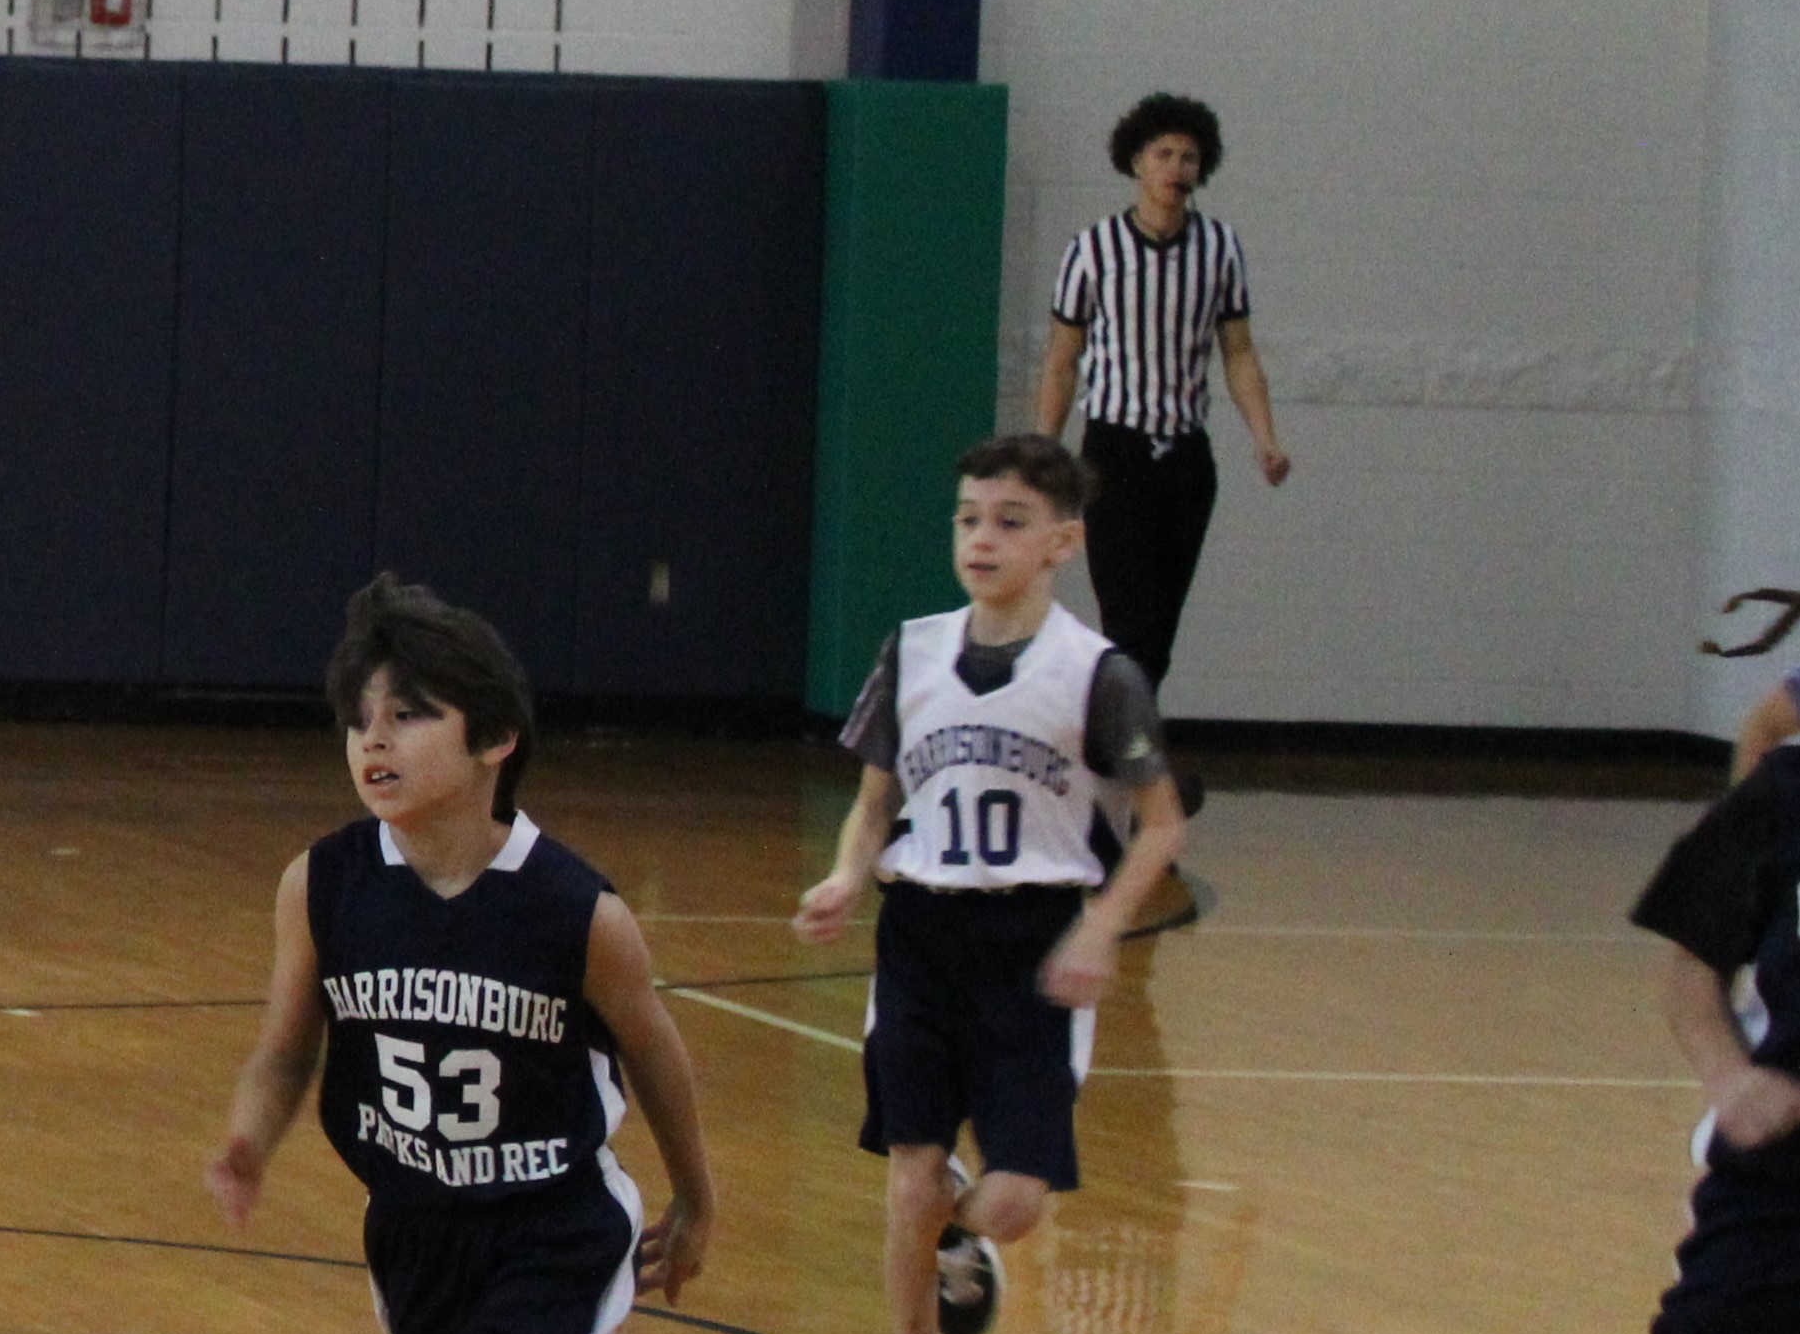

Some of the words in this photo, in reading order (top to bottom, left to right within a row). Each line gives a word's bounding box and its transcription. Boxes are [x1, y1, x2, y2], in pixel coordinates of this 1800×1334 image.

[940, 788, 1022, 866] 10
[323, 968, 567, 1044] HARRISONBURG
[374, 1033, 502, 1143] 53
[435, 1145, 496, 1187] AND
[500, 1138, 570, 1183] REC
